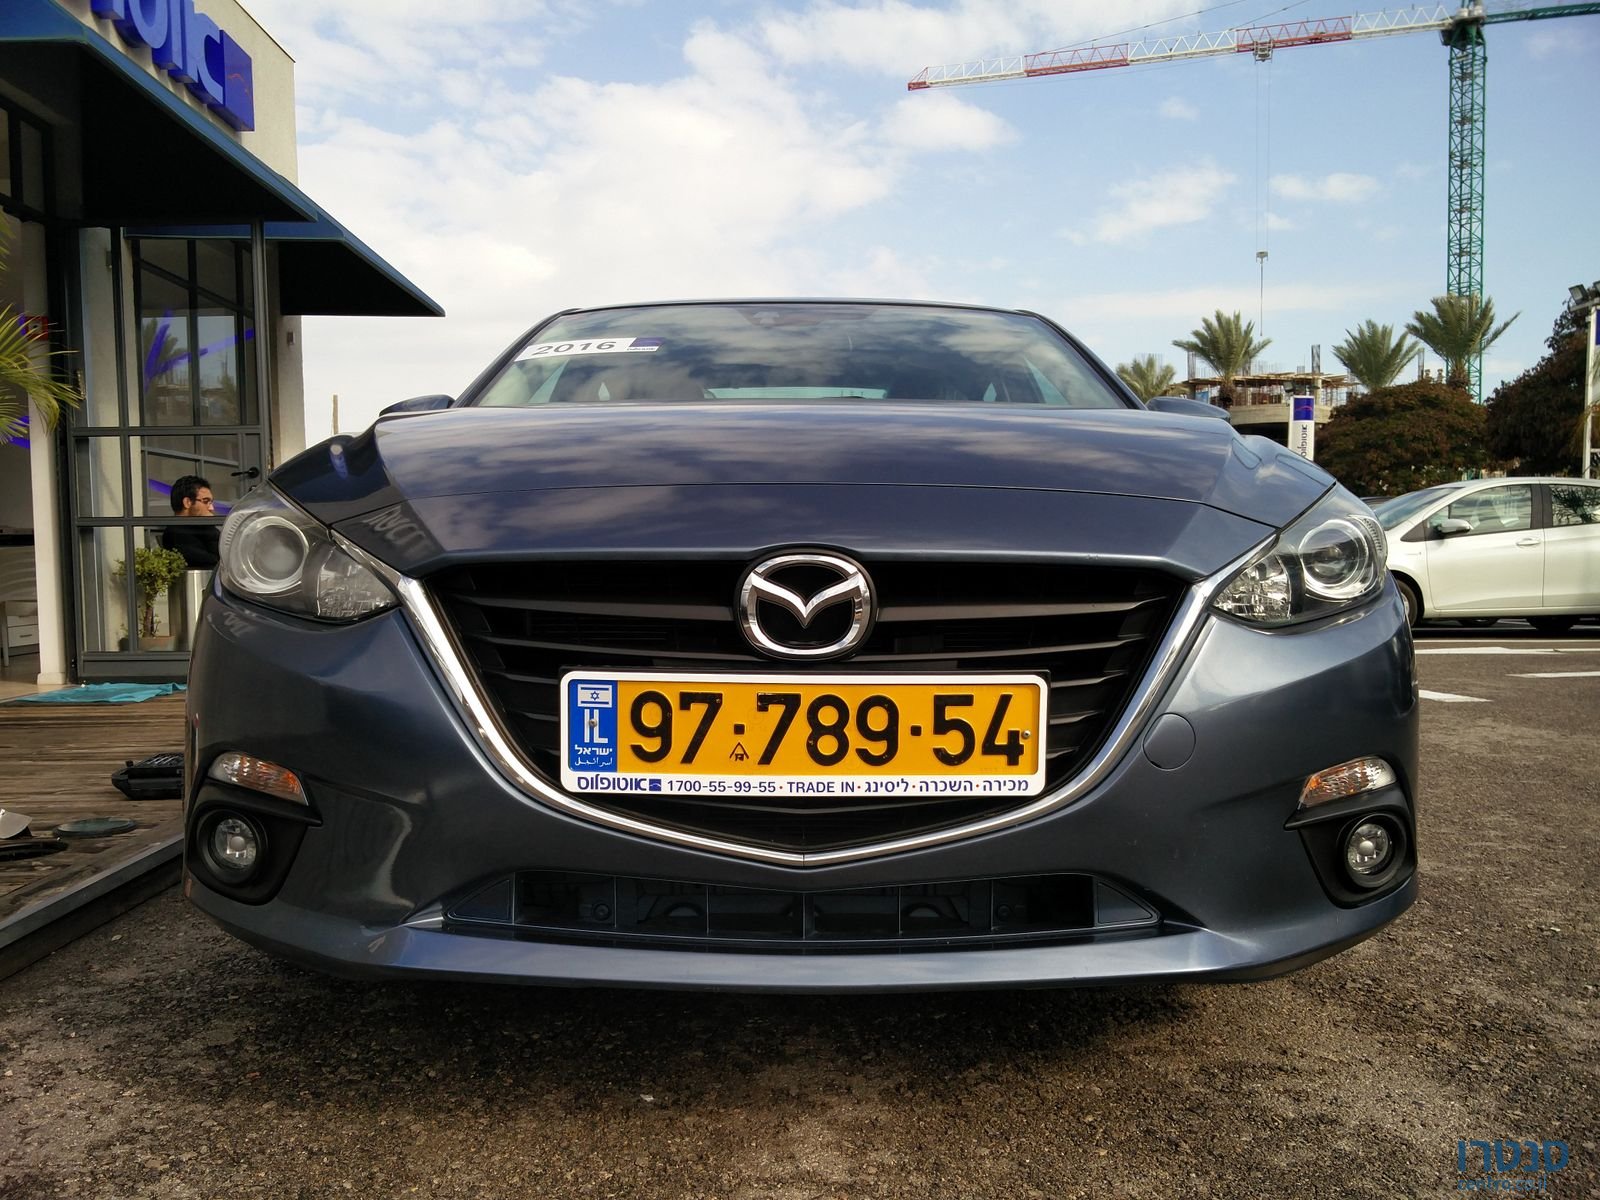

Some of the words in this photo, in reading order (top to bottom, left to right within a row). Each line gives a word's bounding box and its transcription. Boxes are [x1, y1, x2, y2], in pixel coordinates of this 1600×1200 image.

[532, 341, 616, 355] 2016
[584, 709, 609, 744] IL
[574, 744, 613, 756] ישראל
[667, 780, 776, 794] 1700-55-99-55
[787, 781, 836, 794] TRADE
[841, 781, 856, 794] IN
[864, 778, 909, 794] ליסינג
[919, 780, 973, 793] השכרה
[983, 779, 1029, 792] מכירה
